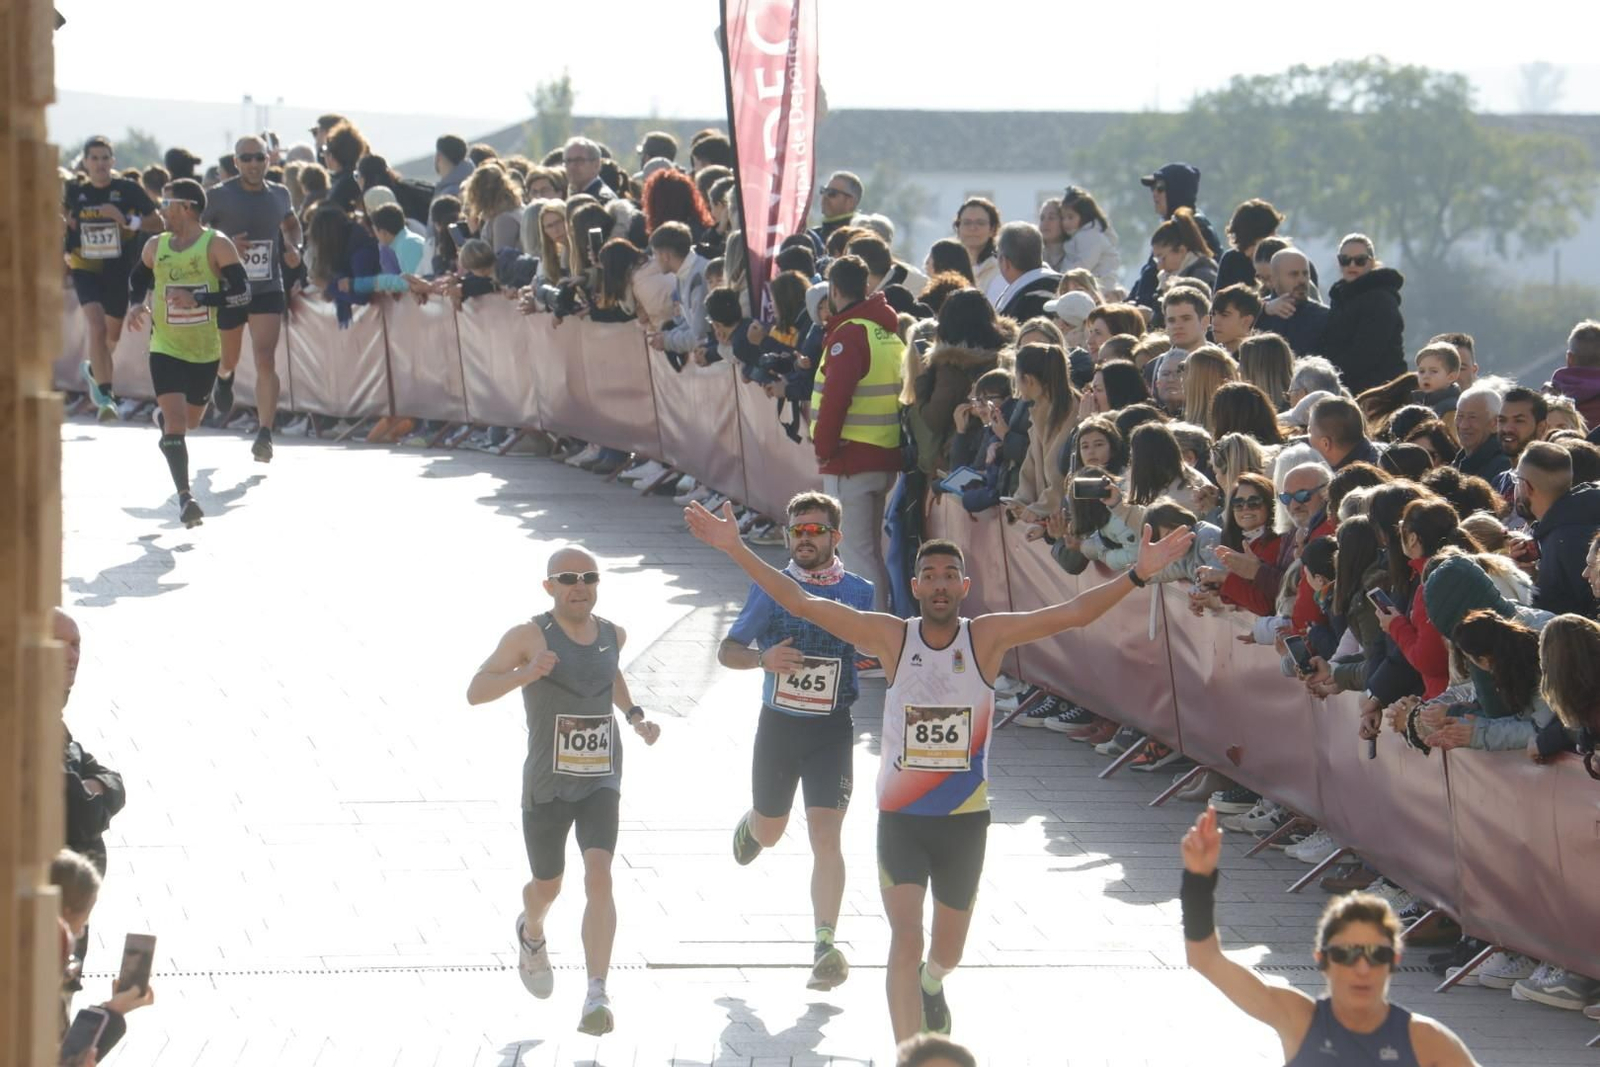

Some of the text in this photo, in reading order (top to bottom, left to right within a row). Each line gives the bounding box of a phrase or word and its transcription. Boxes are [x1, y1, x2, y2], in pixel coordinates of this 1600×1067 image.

[788, 28, 807, 123] Deportes
[791, 128, 806, 157] de
[243, 253, 268, 265] 905
[787, 674, 826, 692] 465
[563, 732, 608, 751] 1084
[916, 724, 959, 743] 856
